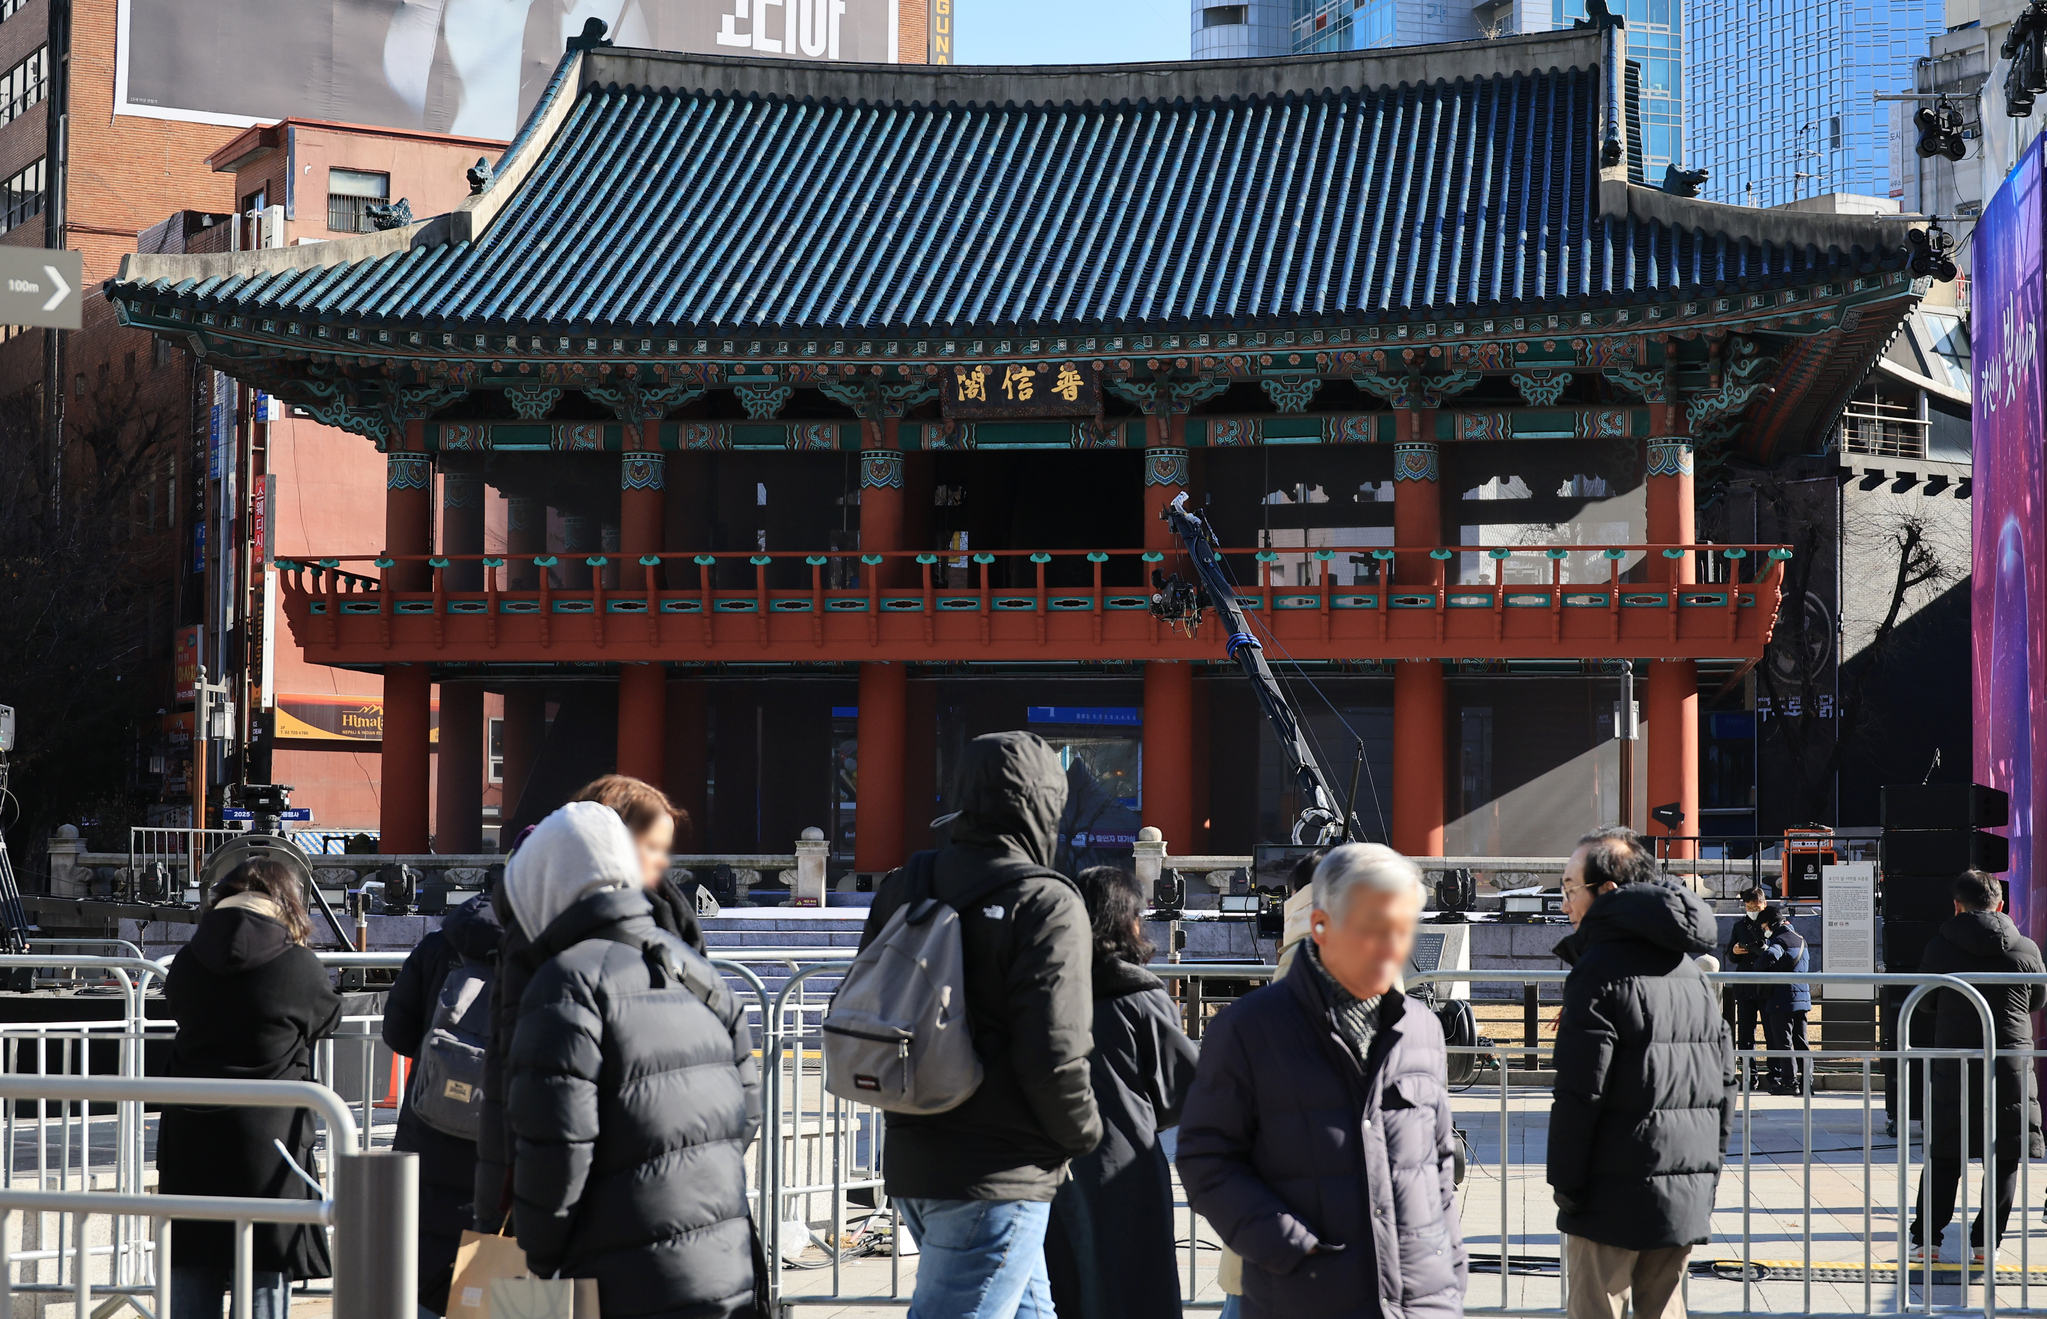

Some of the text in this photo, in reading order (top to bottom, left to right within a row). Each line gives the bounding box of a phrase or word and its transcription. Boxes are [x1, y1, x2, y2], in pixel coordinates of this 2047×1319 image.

[1427, 3, 1447, 23] 가
[8, 279, 39, 293] 100m
[255, 486, 265, 549] 스웨디시
[342, 714, 383, 731] Himal
